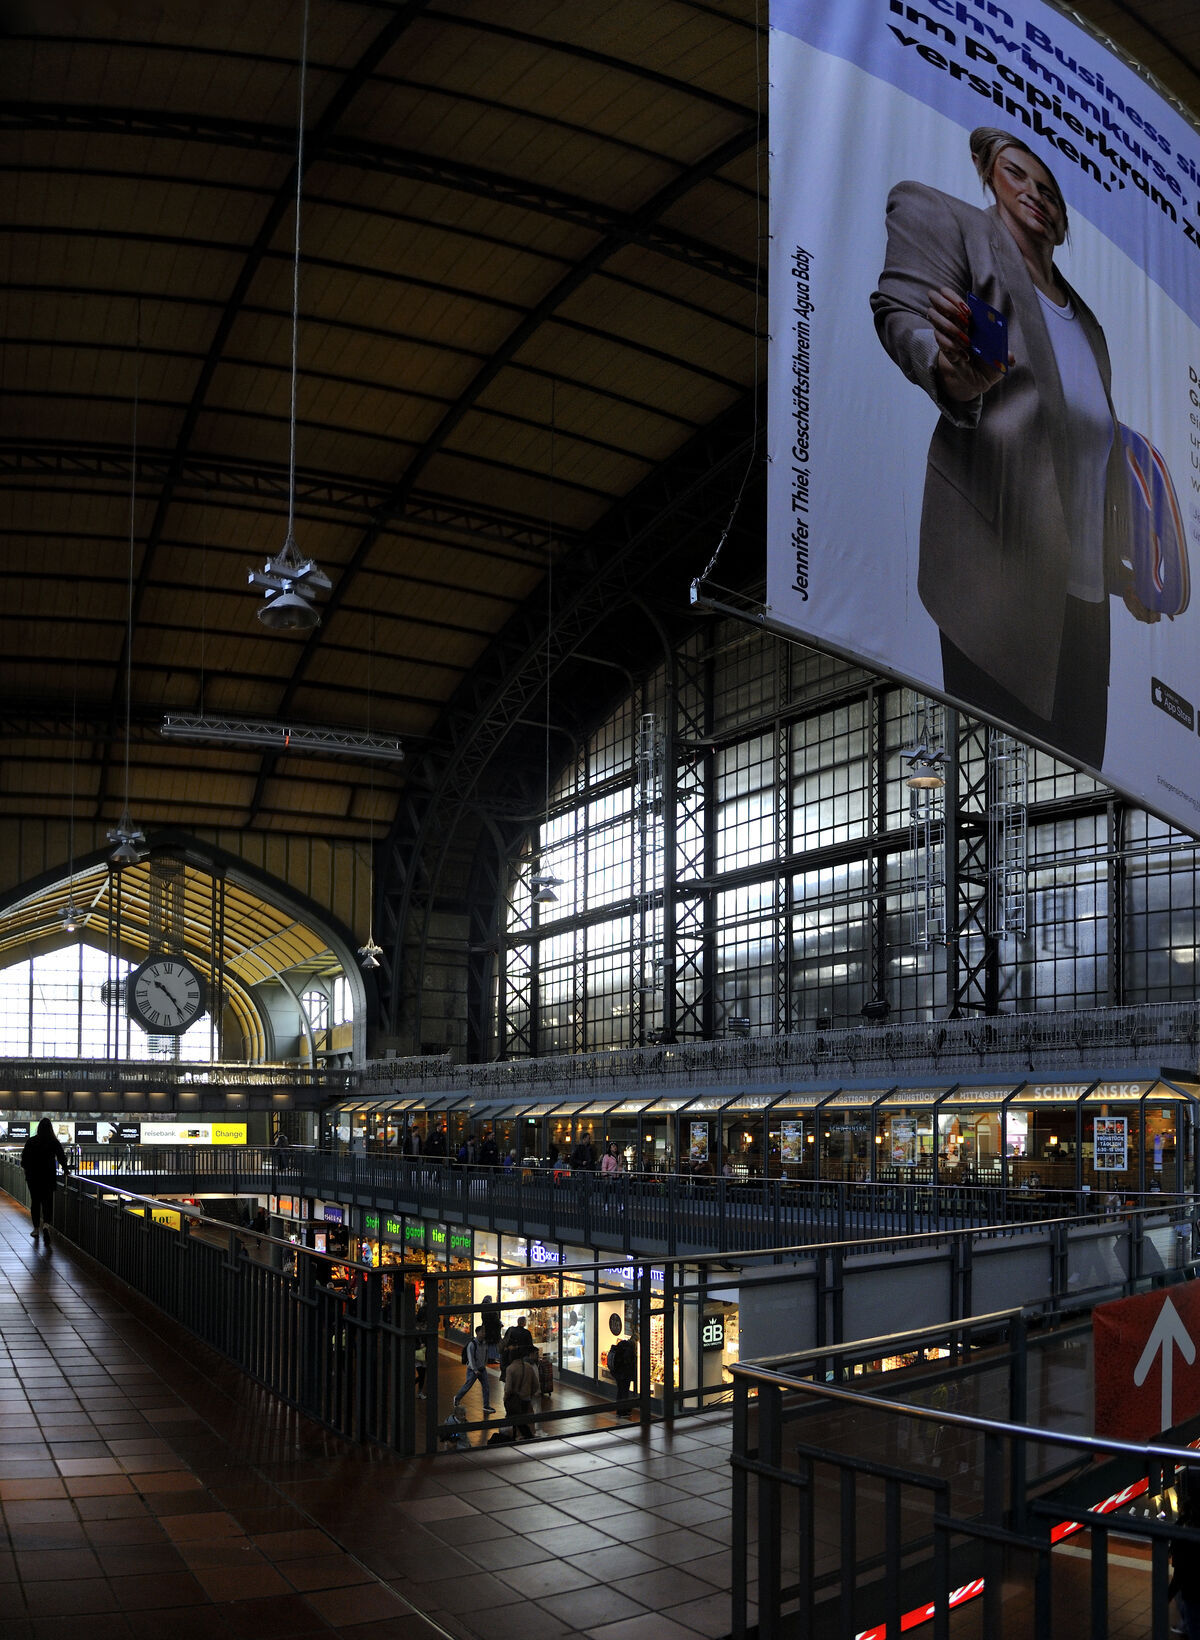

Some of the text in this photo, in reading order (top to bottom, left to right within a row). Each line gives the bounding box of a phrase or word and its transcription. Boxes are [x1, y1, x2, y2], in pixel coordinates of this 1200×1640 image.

[1026, 21, 1171, 155] Business
[965, 35, 1177, 224] Papierkram
[791, 245, 815, 602] Jennifer Thiel, Geschäftsführerin Agua Baby
[1164, 697, 1192, 725] App Store
[893, 1091, 935, 1102] FRÜHSTÜCK
[144, 1128, 176, 1137] reisebank
[215, 1129, 243, 1139] Change
[386, 1219, 400, 1234] tier
[432, 1229, 446, 1243] tier
